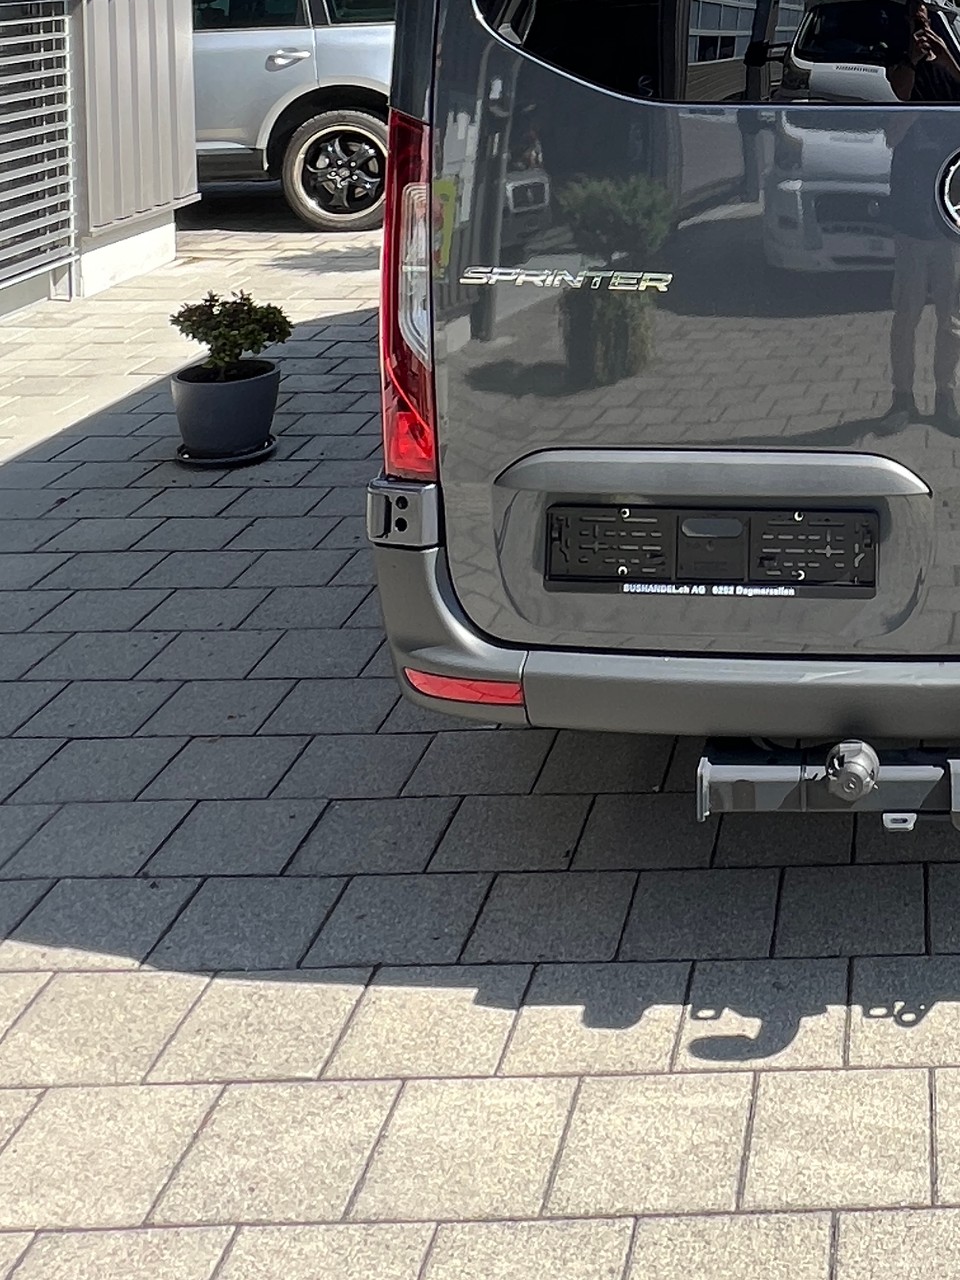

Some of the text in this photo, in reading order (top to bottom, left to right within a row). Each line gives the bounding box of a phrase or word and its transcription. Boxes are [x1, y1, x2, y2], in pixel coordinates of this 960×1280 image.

[459, 266, 673, 292] SPRINTER
[623, 583, 689, 594] BUSHANDEL.ch
[690, 585, 706, 595] AG
